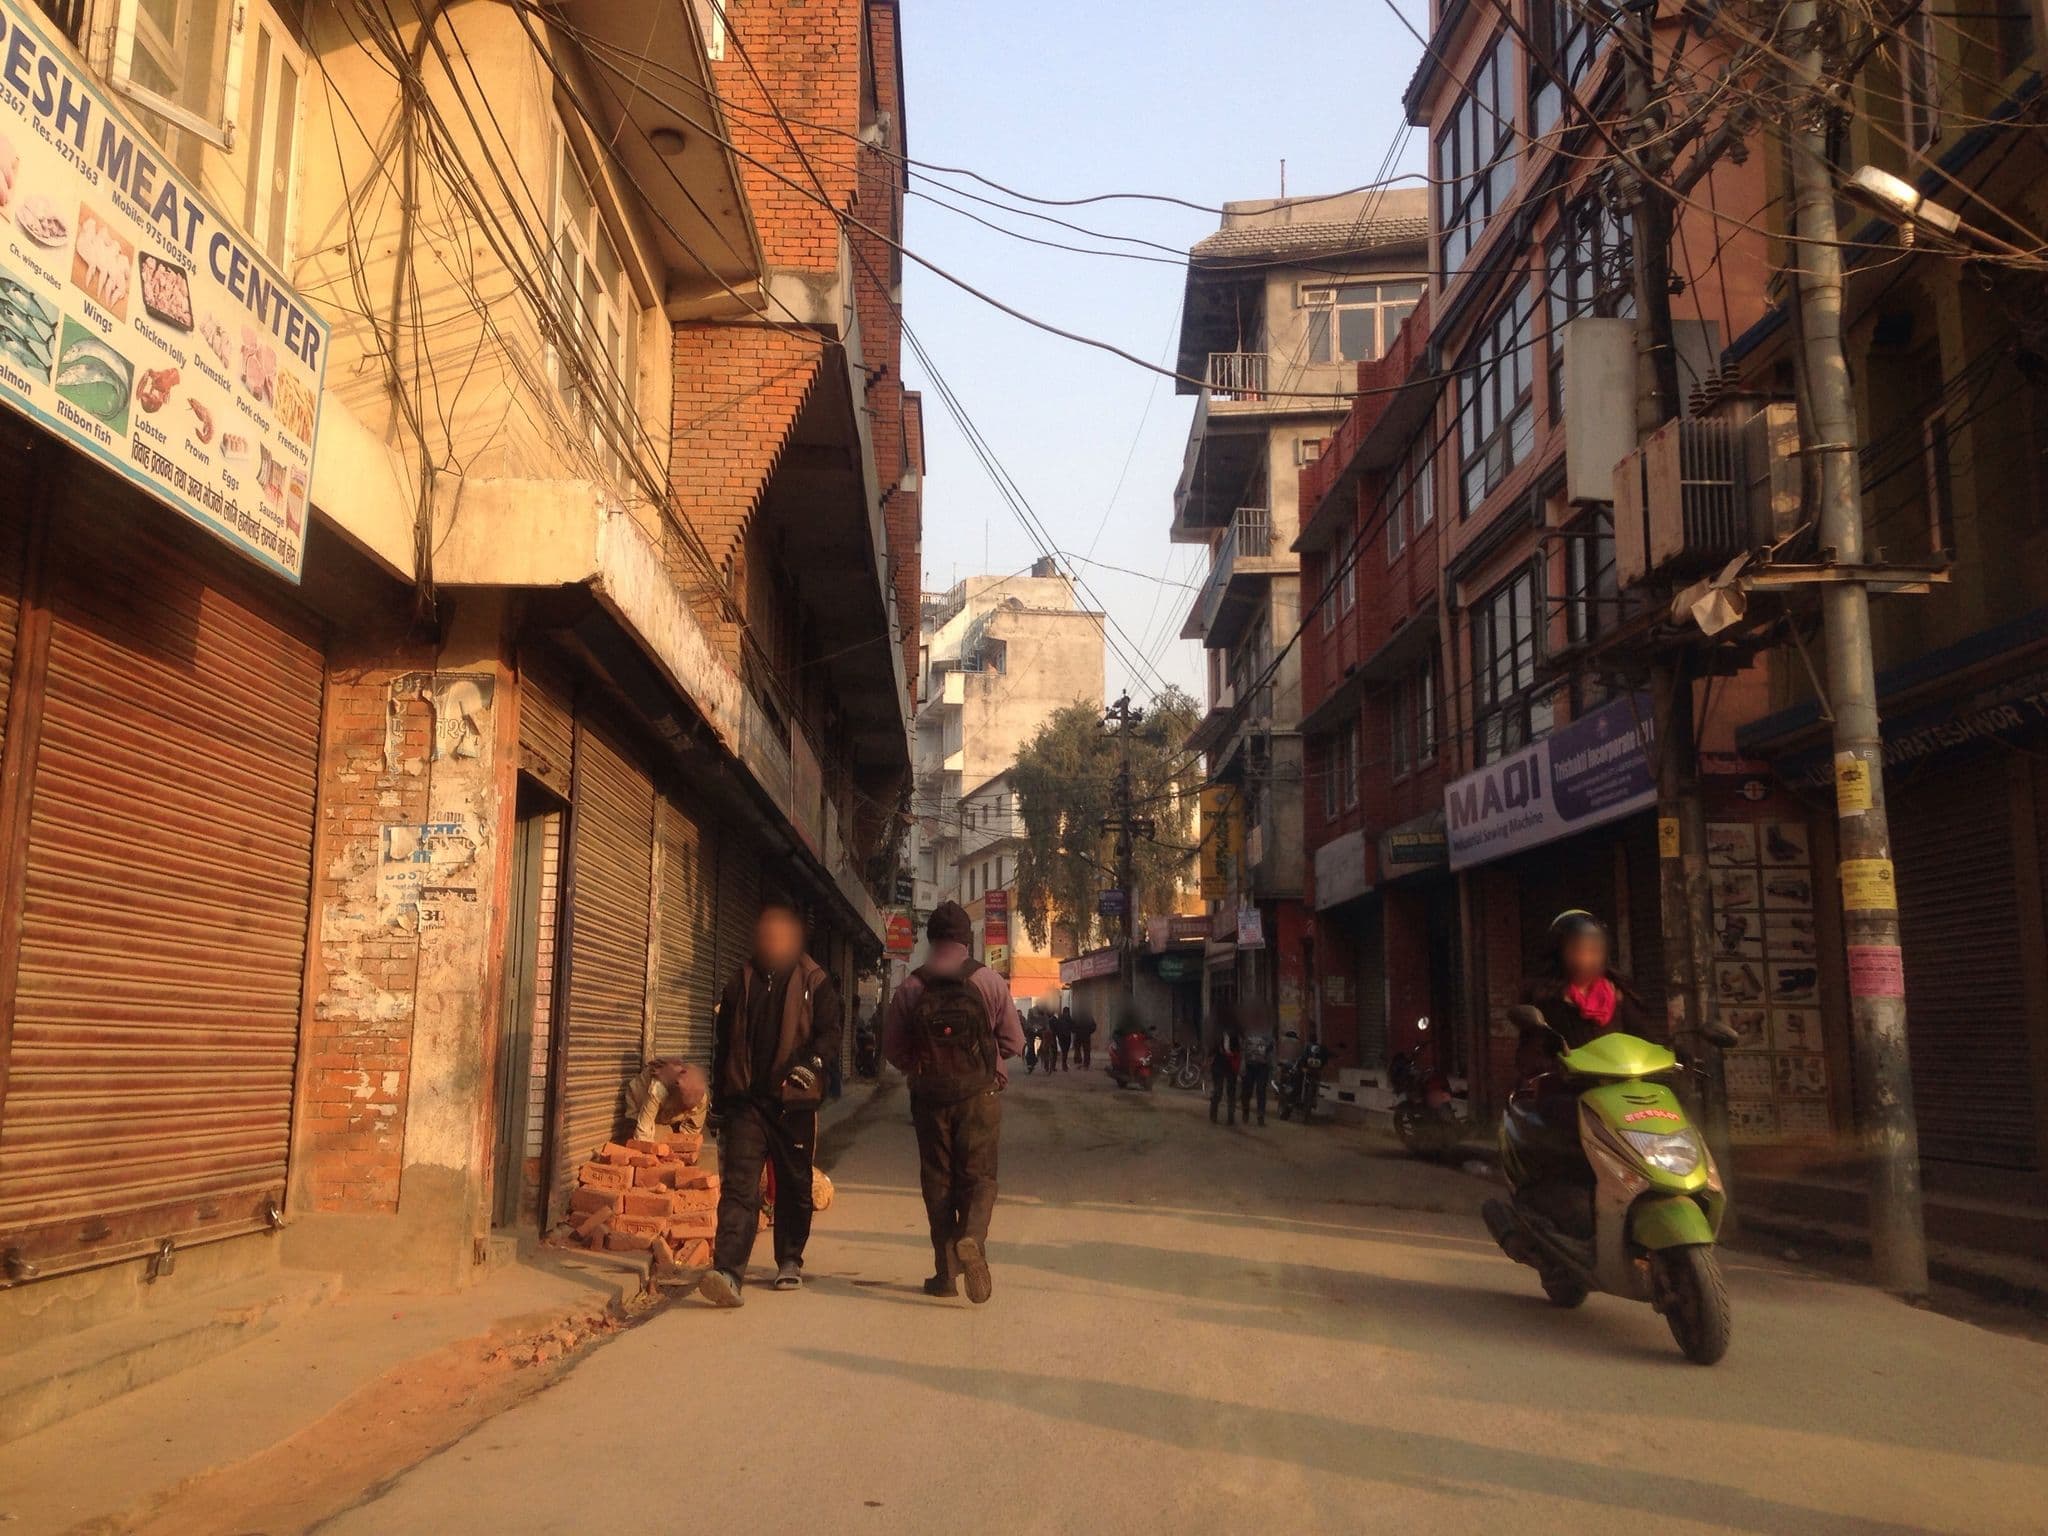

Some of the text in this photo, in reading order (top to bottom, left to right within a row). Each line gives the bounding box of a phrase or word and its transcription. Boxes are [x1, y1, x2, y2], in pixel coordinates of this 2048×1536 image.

[0, 8, 320, 372] ESH MEAT CENTER
[32, 115, 53, 145] Res.
[55, 139, 98, 186] 4271363
[112, 190, 144, 229] Mobile:
[146, 223, 197, 276] 9751003594
[9, 243, 62, 290] Ch. wings cubes
[83, 299, 113, 333] Wings
[134, 317, 187, 369] Chicken lolly
[194, 354, 231, 392] Drumstick
[56, 399, 111, 445] Ribbon fish
[134, 415, 168, 445] Lobster
[236, 396, 270, 434] Pork chop
[184, 438, 210, 466] Prown
[277, 431, 309, 467] French fry
[173, 465, 188, 491] तथा
[221, 468, 240, 491] Eggs
[259, 501, 285, 529] Sausage
[1449, 752, 1541, 831] MAQI
[1508, 811, 1544, 834] Machine
